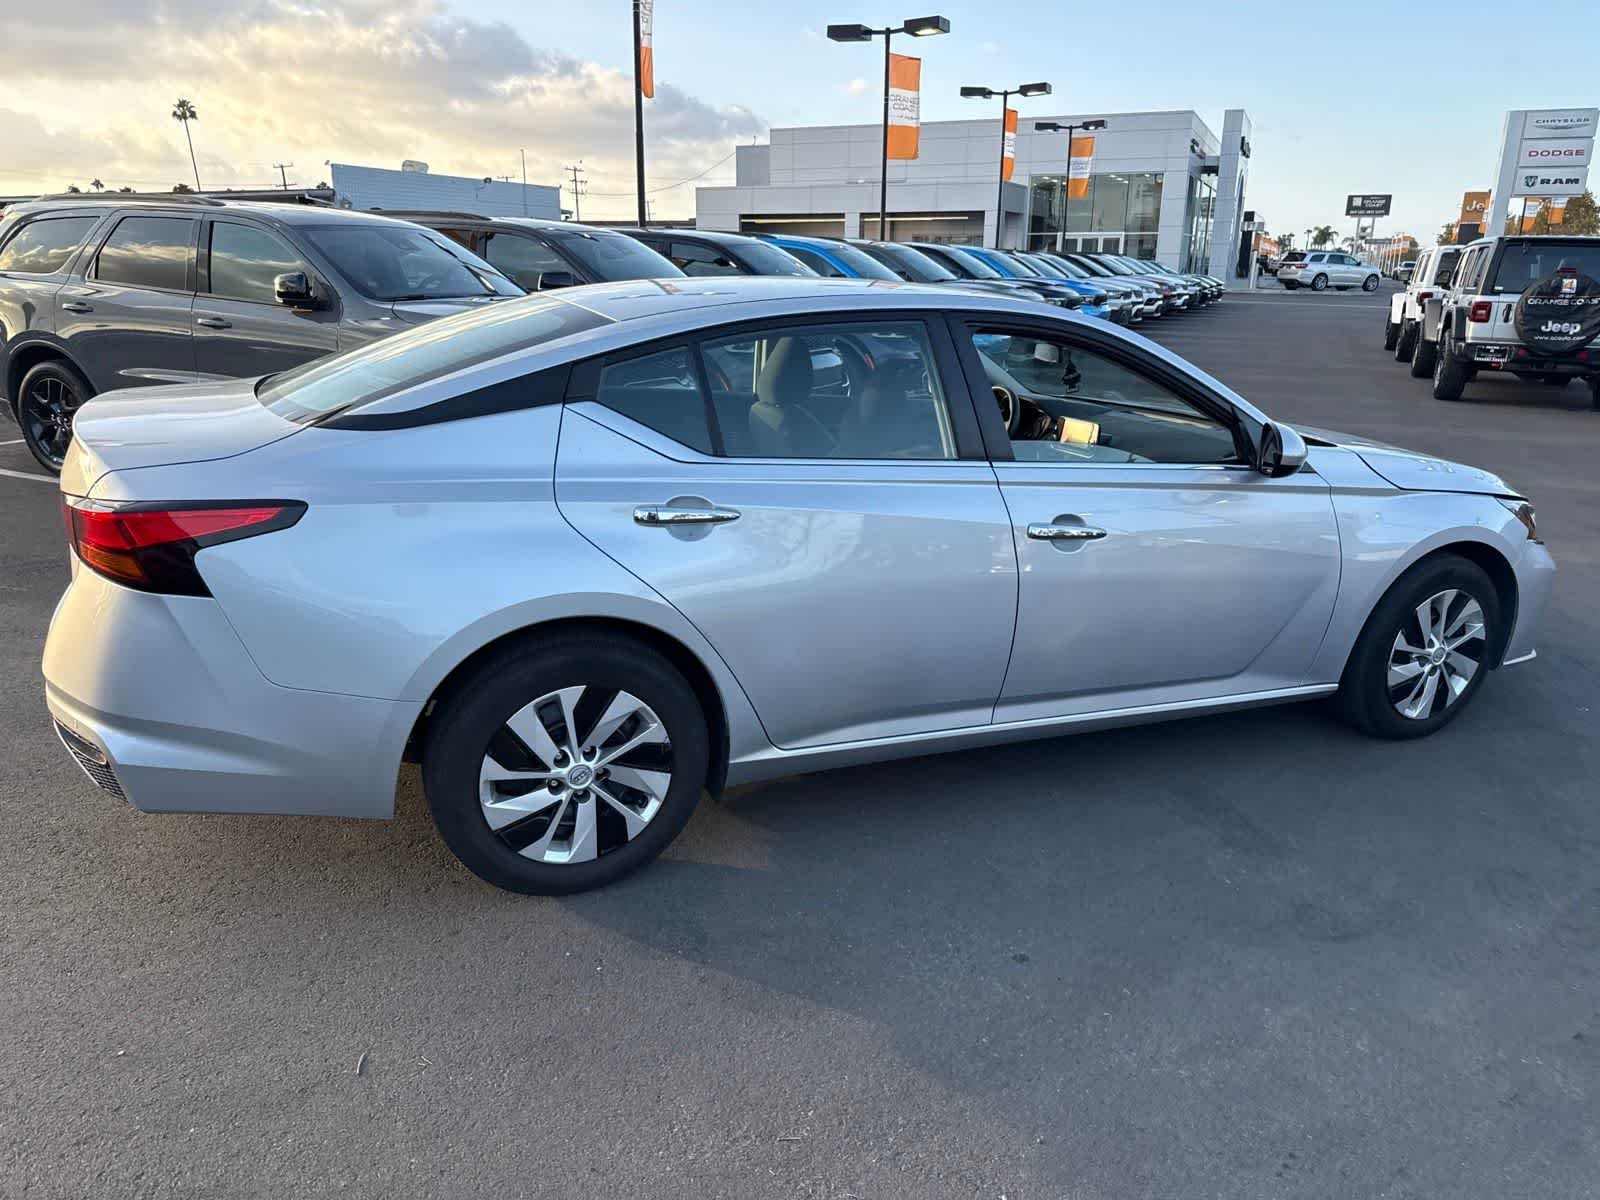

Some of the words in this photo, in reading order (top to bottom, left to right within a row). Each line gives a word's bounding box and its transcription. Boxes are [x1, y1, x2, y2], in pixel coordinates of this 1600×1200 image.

[1528, 149, 1585, 157] DODGE
[1466, 199, 1485, 211] Je
[1541, 320, 1581, 335] Jeep
